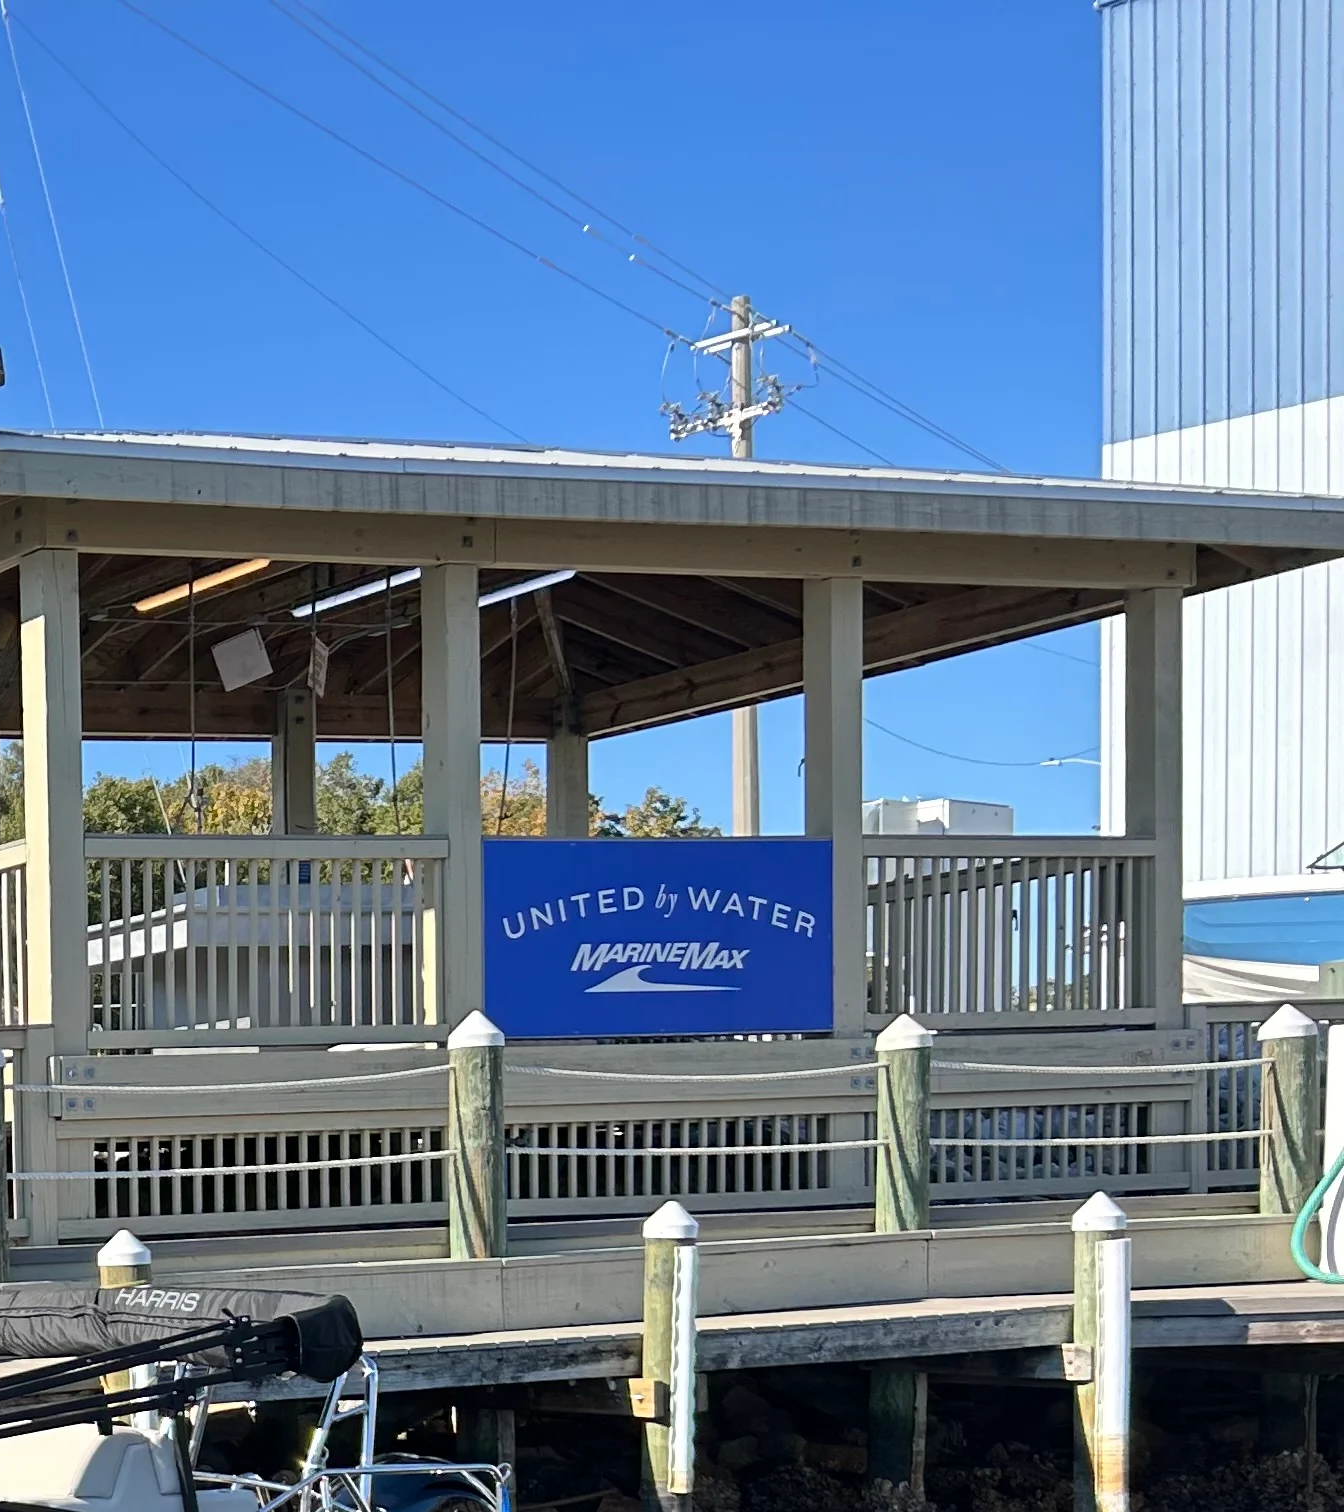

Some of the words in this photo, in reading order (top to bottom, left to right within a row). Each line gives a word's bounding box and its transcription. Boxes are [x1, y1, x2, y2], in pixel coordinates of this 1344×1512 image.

[502, 886, 645, 939] UNITED
[655, 884, 678, 918] by
[687, 886, 817, 938] WATER
[114, 1287, 201, 1312] HARRIS
